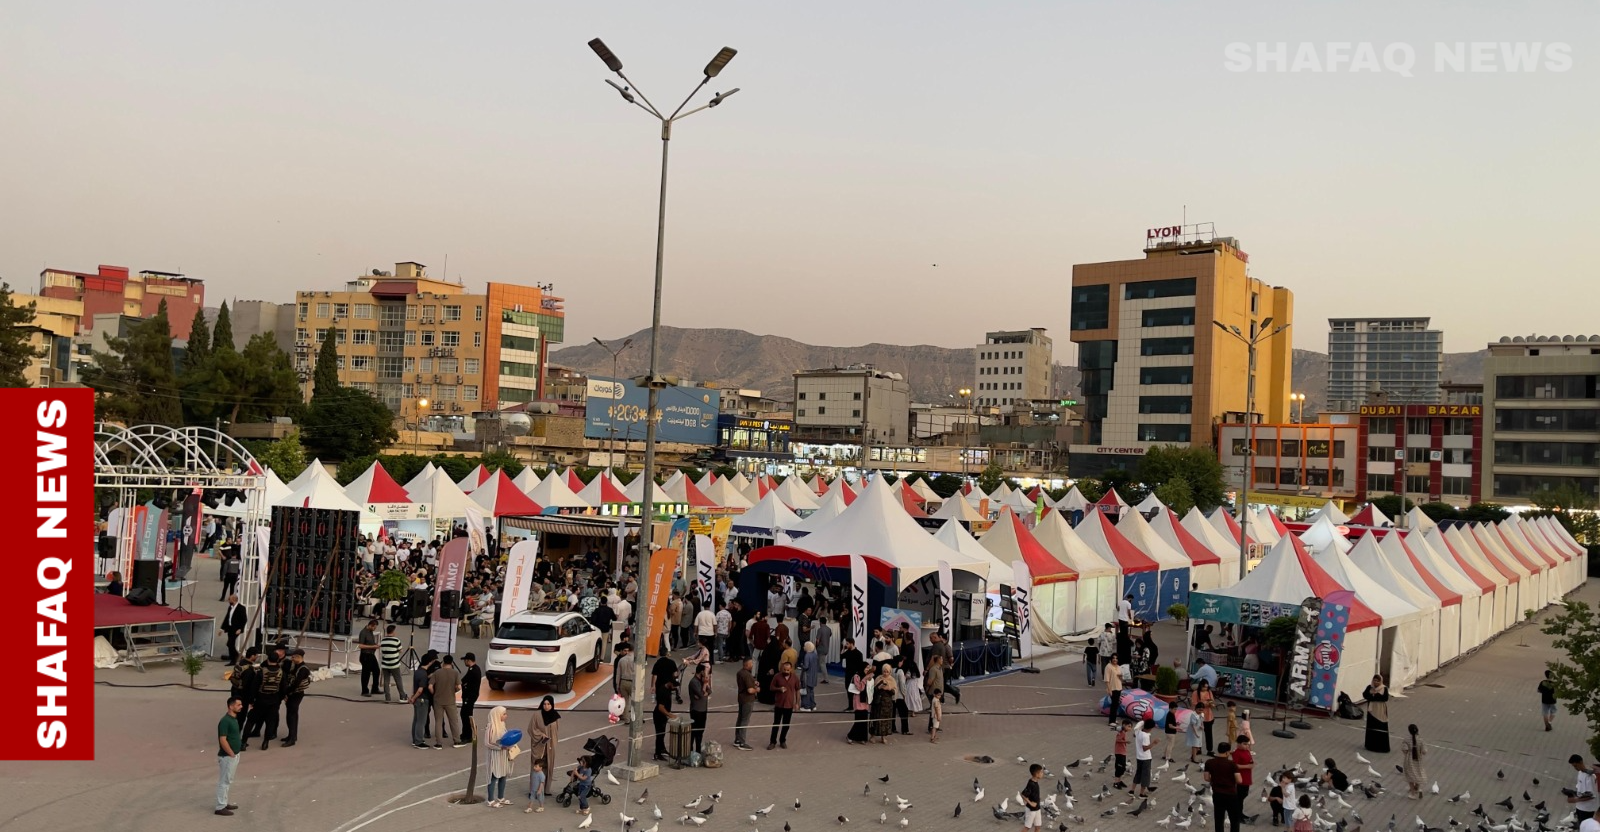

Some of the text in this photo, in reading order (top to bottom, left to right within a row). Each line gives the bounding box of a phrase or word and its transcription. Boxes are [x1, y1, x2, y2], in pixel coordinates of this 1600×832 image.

[1147, 225, 1182, 239] LYON
[1360, 406, 1480, 415] DUBAI BAZAR
[1201, 607, 1220, 615] ARMY
[1289, 629, 1312, 697] ARMY
